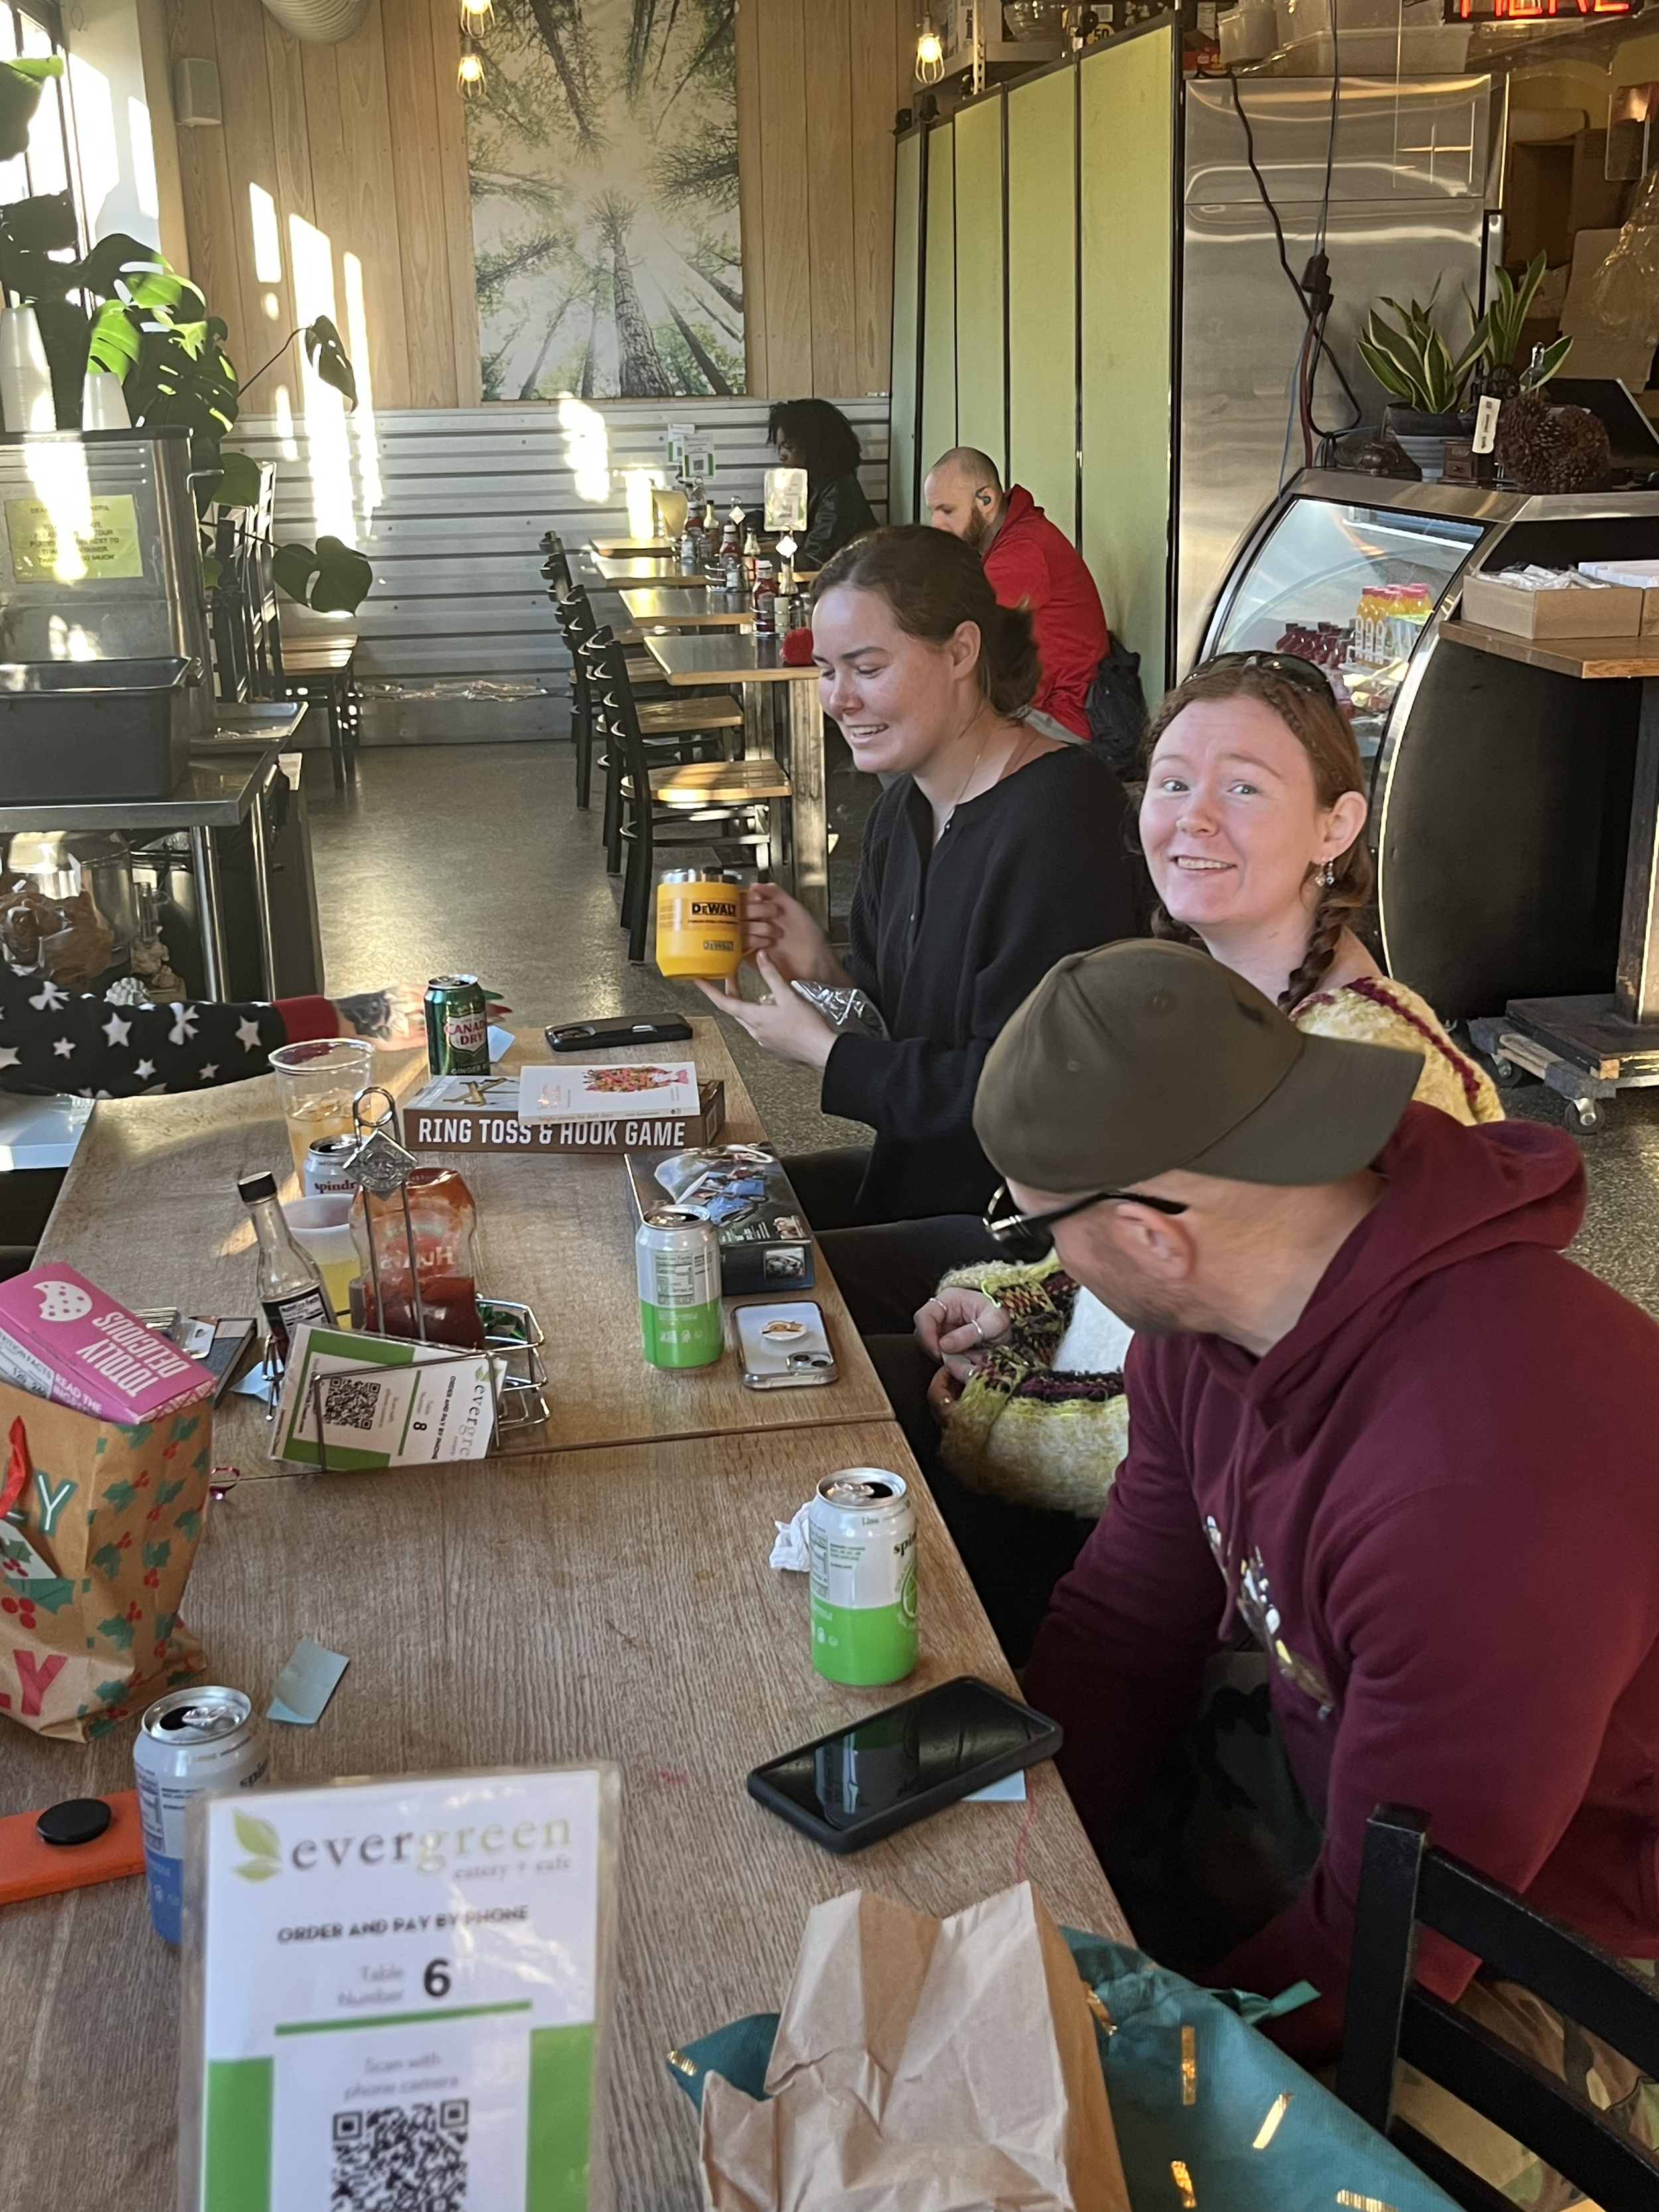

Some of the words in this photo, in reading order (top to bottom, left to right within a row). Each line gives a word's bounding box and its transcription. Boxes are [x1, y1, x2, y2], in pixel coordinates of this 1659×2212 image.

[692, 902, 737, 917] DEWALT
[461, 1033, 483, 1045] DRY
[451, 1065, 481, 1075] GINGER
[418, 1118, 472, 1143] RING
[478, 1119, 532, 1145] TOSS
[538, 1124, 553, 1145] &
[560, 1122, 618, 1145] HOOK
[624, 1122, 685, 1147] GAME
[92, 1311, 192, 1378] DELICIOUS
[76, 1339, 159, 1398] TOTOLLY
[55, 1373, 82, 1398] READ
[82, 1393, 102, 1415] THE
[447, 1376, 456, 1398] ORDER
[413, 1422, 427, 1430] 8
[438, 1428, 444, 1436] BY
[292, 1817, 571, 1877] evergreen
[454, 1862, 507, 1881] eatery
[277, 1923, 342, 1945] ORDER
[348, 1918, 388, 1937] AND
[394, 1913, 432, 1933] PAY
[436, 1911, 458, 1929] BY
[465, 1904, 530, 1925] PHONE
[338, 1988, 403, 2007] Number
[424, 1957, 451, 1998] 6
[363, 1964, 403, 1982] Table
[365, 2057, 403, 2075] Scan
[409, 2052, 441, 2069] with
[344, 2081, 396, 2102] phone
[400, 2077, 459, 2094] camera
